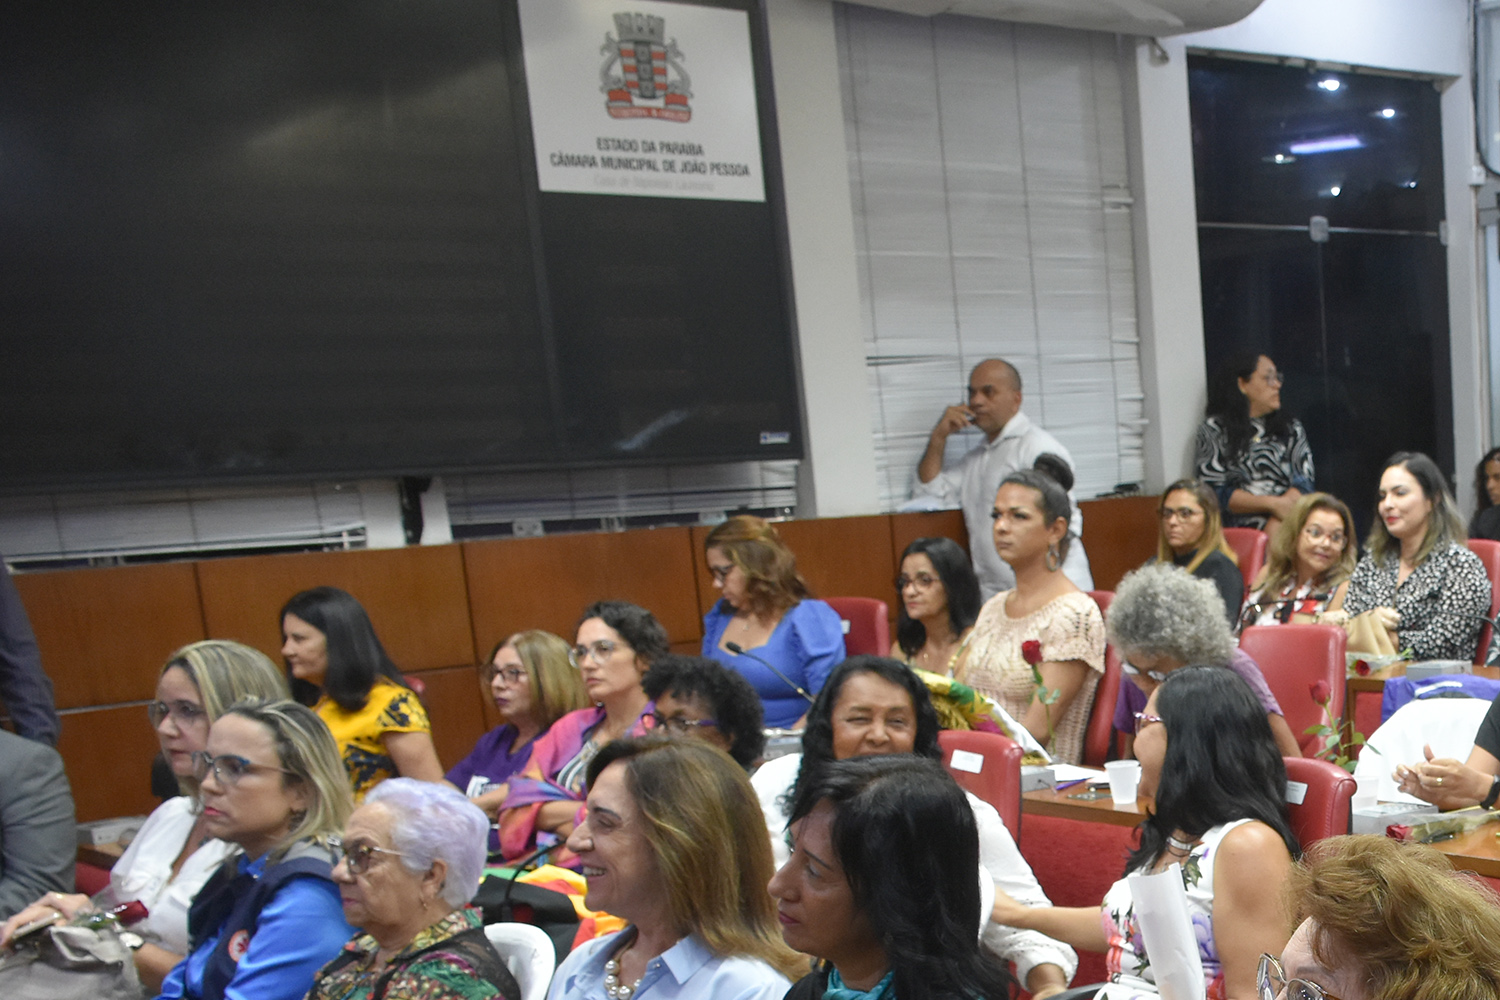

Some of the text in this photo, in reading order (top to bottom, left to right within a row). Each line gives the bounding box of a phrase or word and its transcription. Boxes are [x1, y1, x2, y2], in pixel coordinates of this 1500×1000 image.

[596, 137, 639, 152] ESTADO
[641, 140, 657, 153] DA
[550, 150, 750, 176] CÂMARA MUNICIPAL DE JOÃO PESSOA
